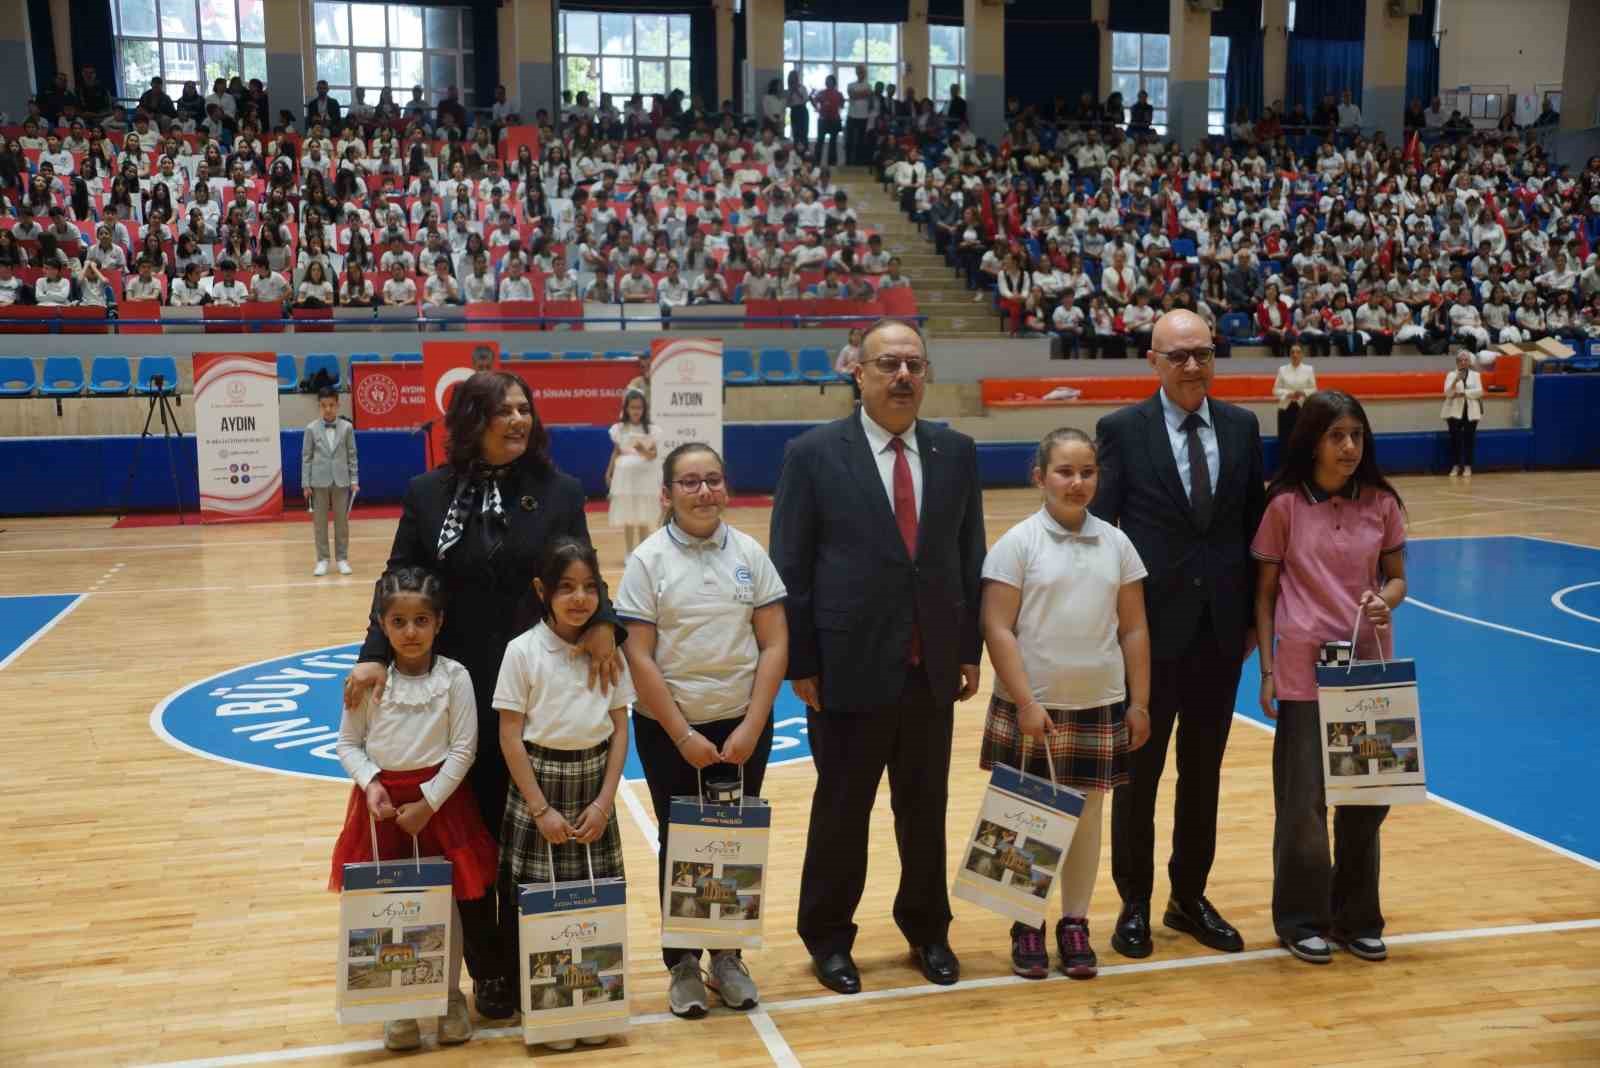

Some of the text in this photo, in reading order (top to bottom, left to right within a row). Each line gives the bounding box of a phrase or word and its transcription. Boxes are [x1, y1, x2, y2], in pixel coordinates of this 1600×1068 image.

[574, 388, 597, 398] SPOR
[670, 392, 703, 406] AYDIN
[221, 416, 256, 432] AYDIN
